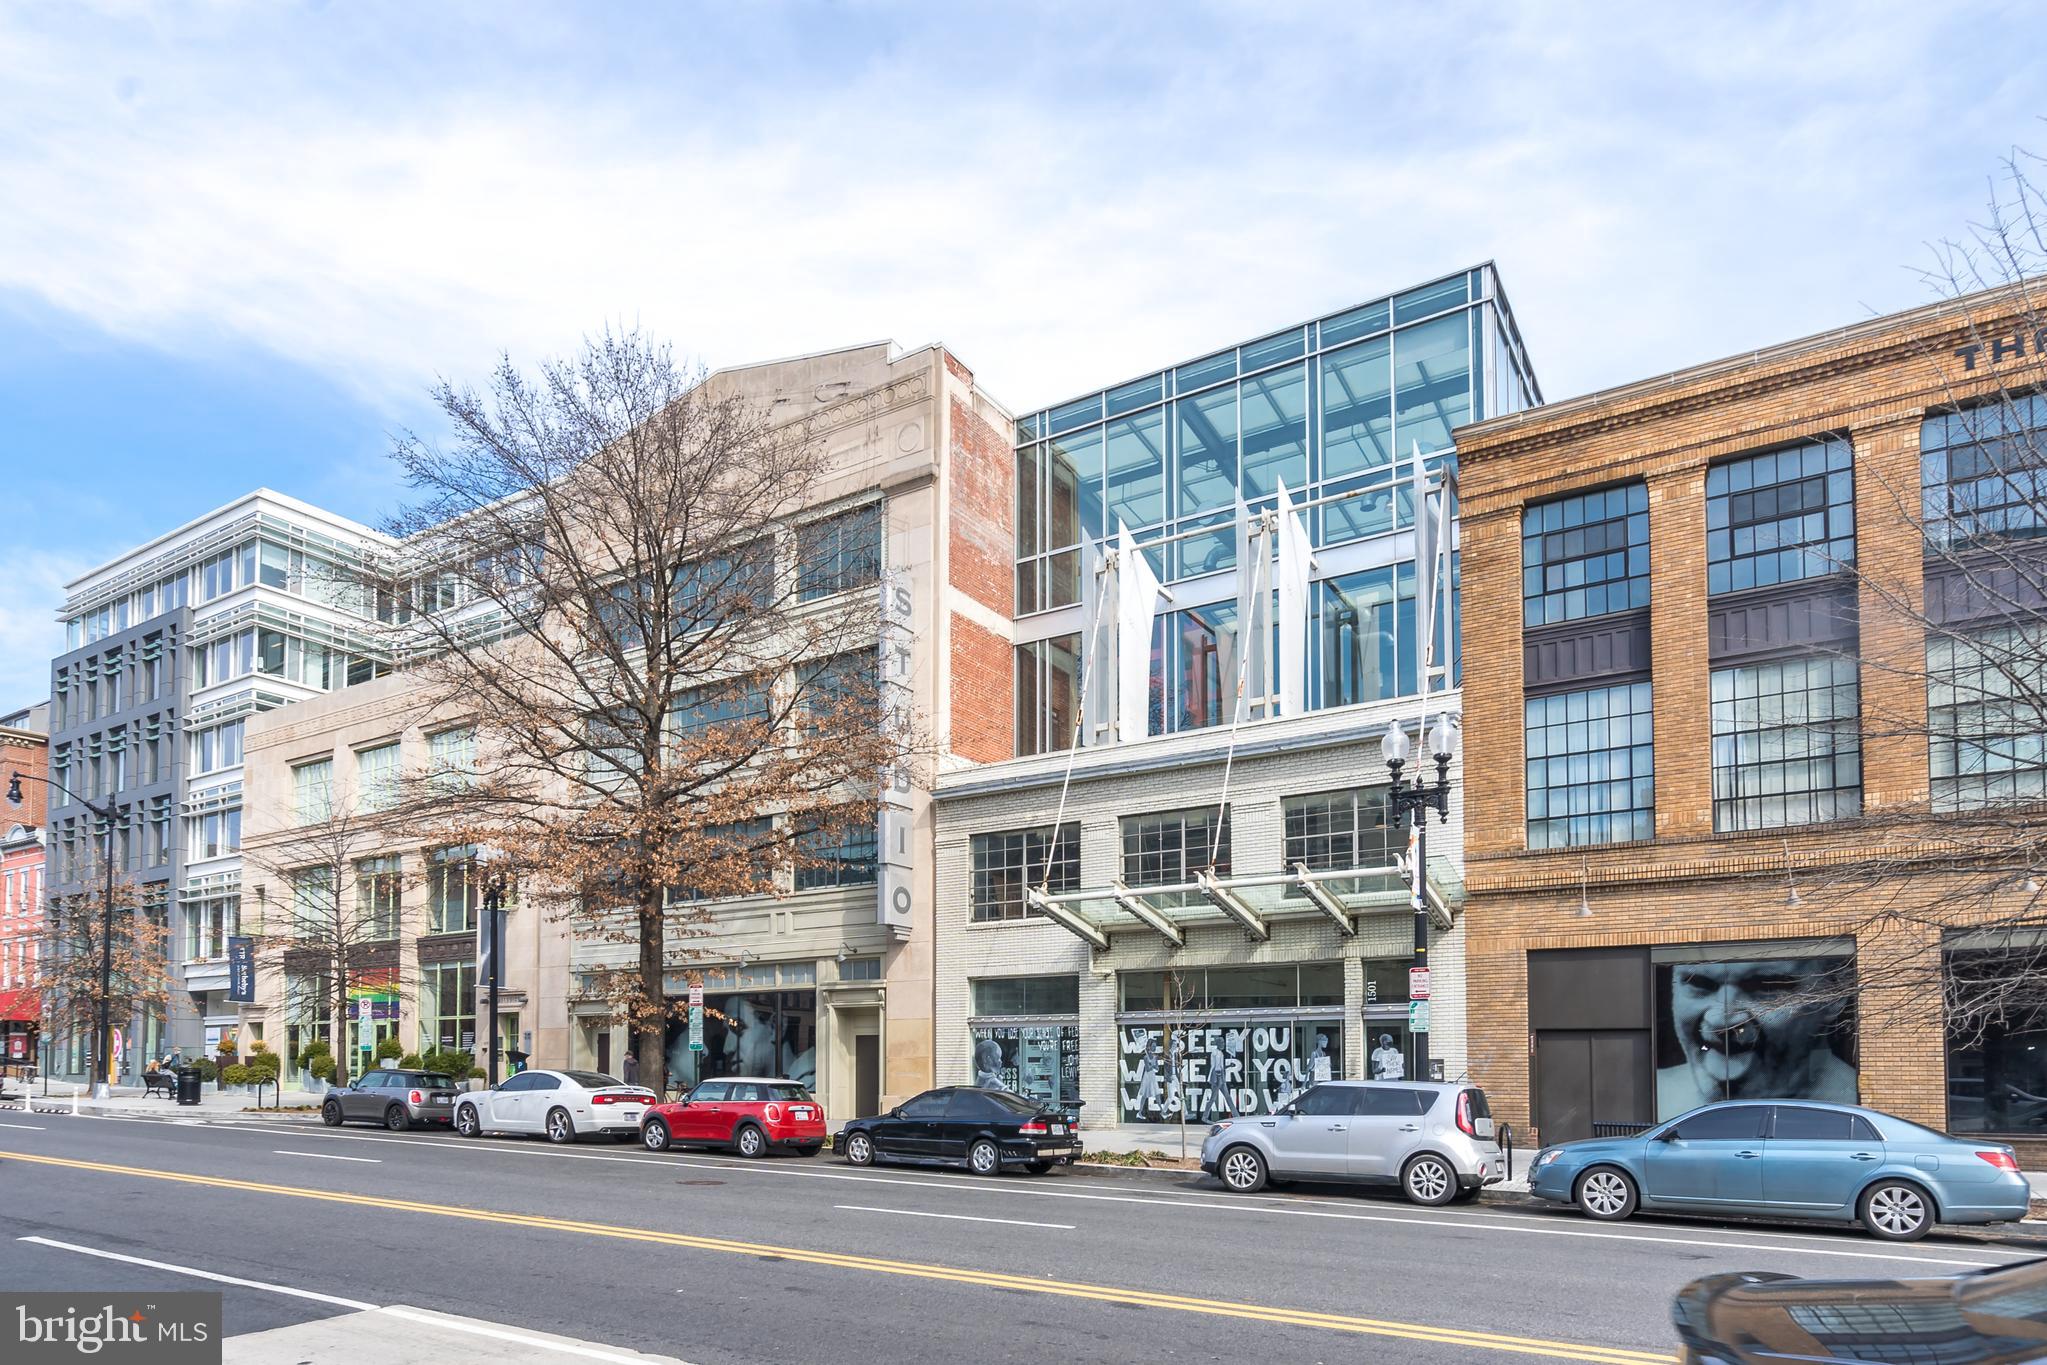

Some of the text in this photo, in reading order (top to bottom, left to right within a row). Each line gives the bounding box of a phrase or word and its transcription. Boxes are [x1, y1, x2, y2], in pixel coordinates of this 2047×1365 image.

[1367, 980, 1377, 1001] 1501
[1062, 1039, 1079, 1052] FREE
[1119, 1030, 1164, 1054] WE
[1171, 1028, 1222, 1054] SEE
[1229, 1026, 1290, 1053] YOU
[1119, 1058, 1165, 1082] WE
[1252, 1057, 1310, 1082] YOU
[1120, 1087, 1164, 1112] WE
